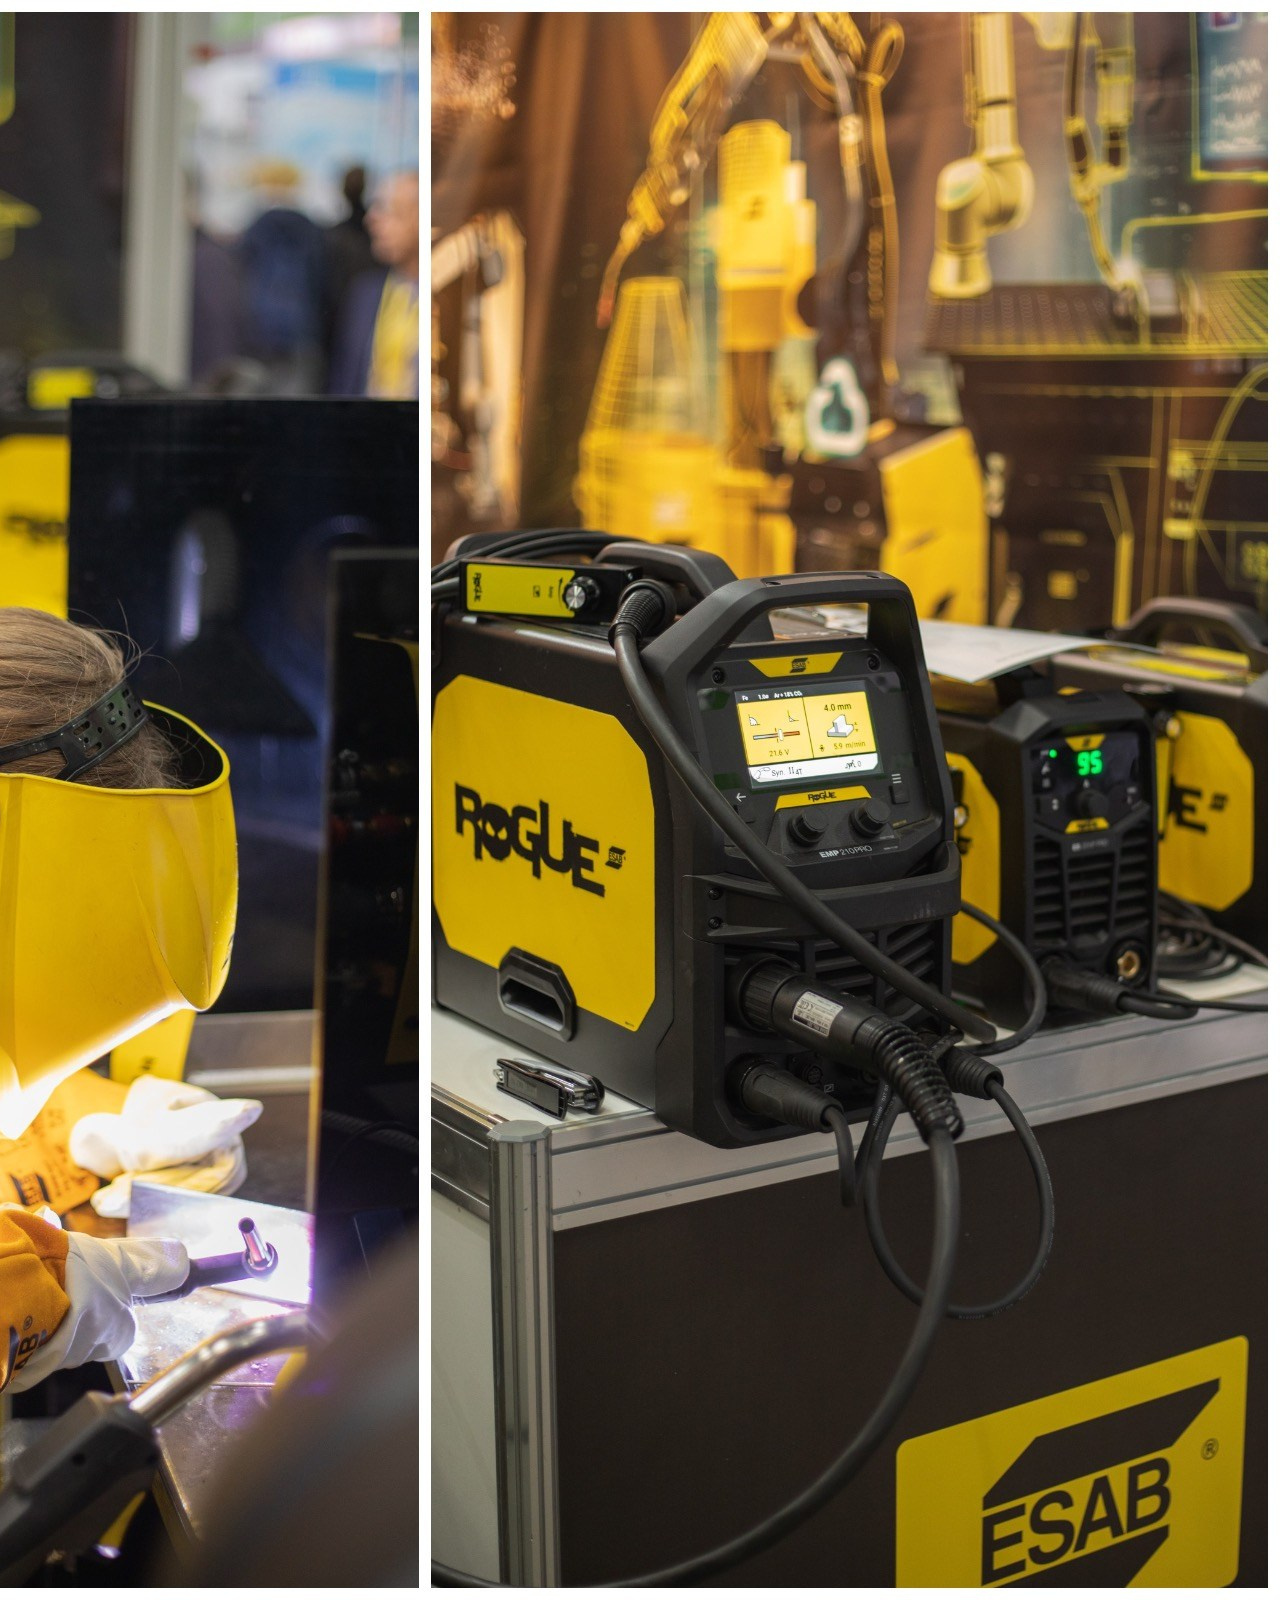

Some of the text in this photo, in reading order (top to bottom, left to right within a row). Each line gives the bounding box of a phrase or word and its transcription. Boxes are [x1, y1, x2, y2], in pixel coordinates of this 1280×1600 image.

[824, 703, 836, 711] 4.0
[833, 741, 866, 750] 5.9 m/min
[1077, 749, 1103, 776] 95
[807, 790, 837, 802] ROGUE
[454, 781, 605, 898] ROGUE
[819, 849, 839, 858] EMP
[982, 1457, 1171, 1586] ESAB
